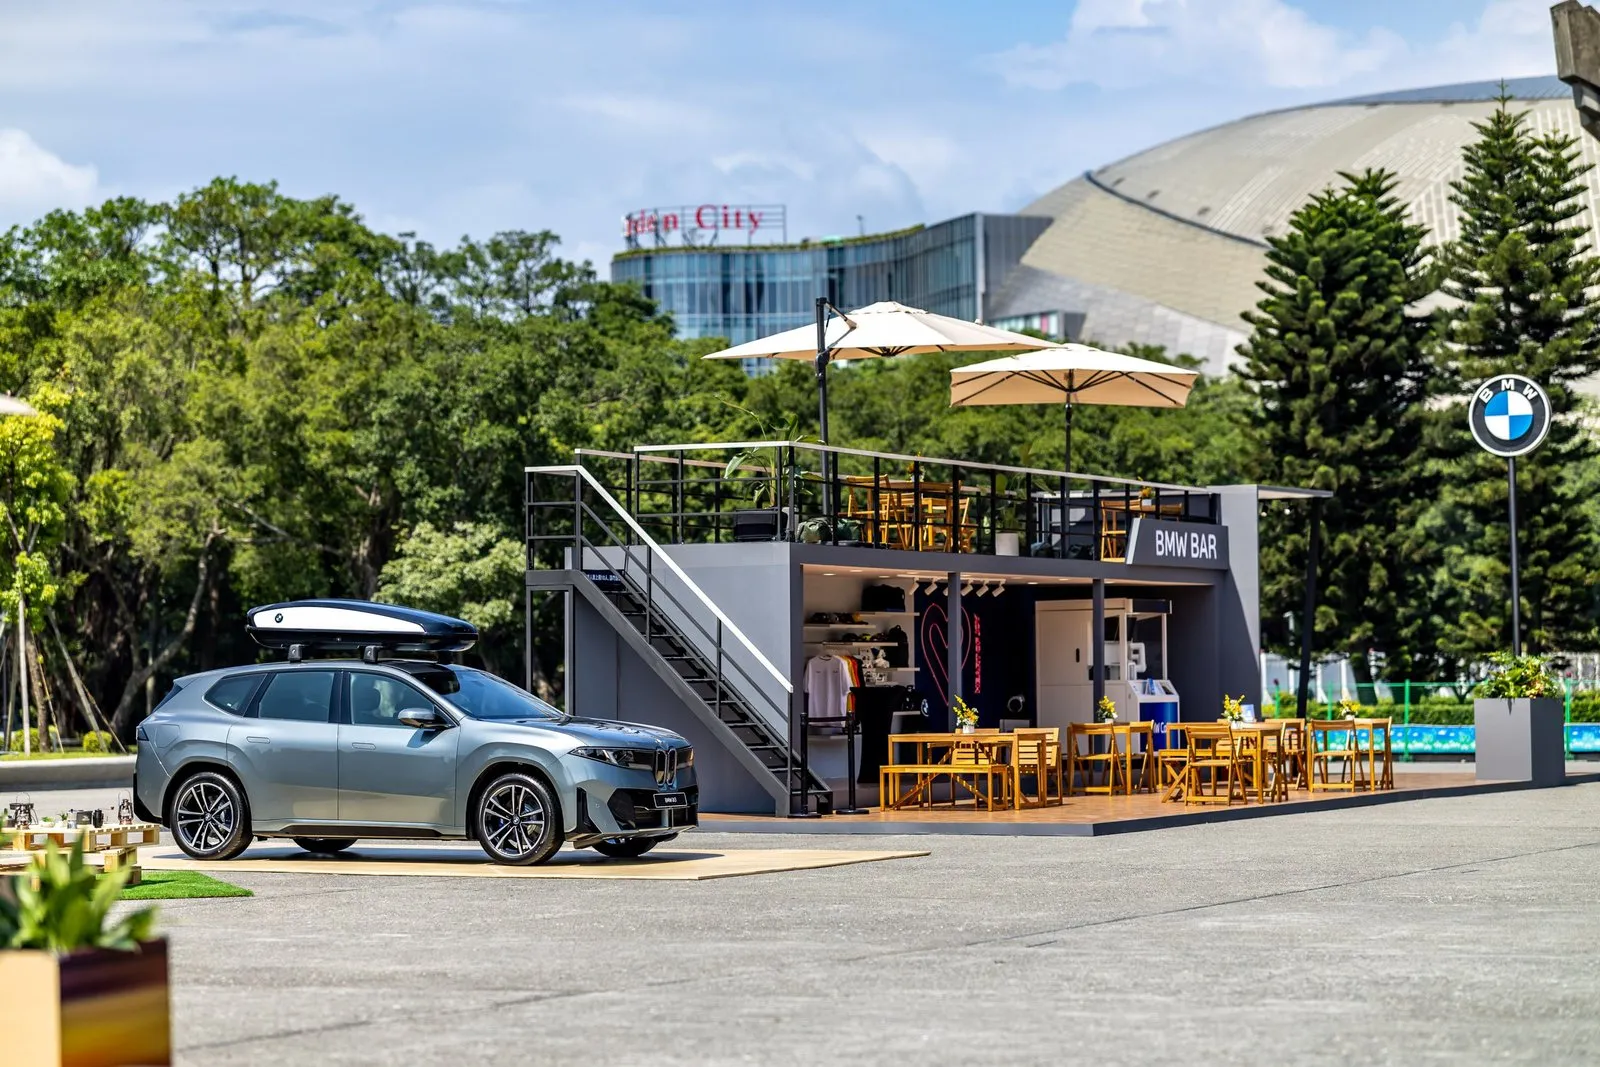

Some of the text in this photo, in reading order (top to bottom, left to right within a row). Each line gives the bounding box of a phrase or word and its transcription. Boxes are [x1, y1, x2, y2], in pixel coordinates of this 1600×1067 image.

[695, 204, 763, 236] City
[1479, 379, 1538, 404] BMW
[1155, 529, 1217, 560] BMW BAR
